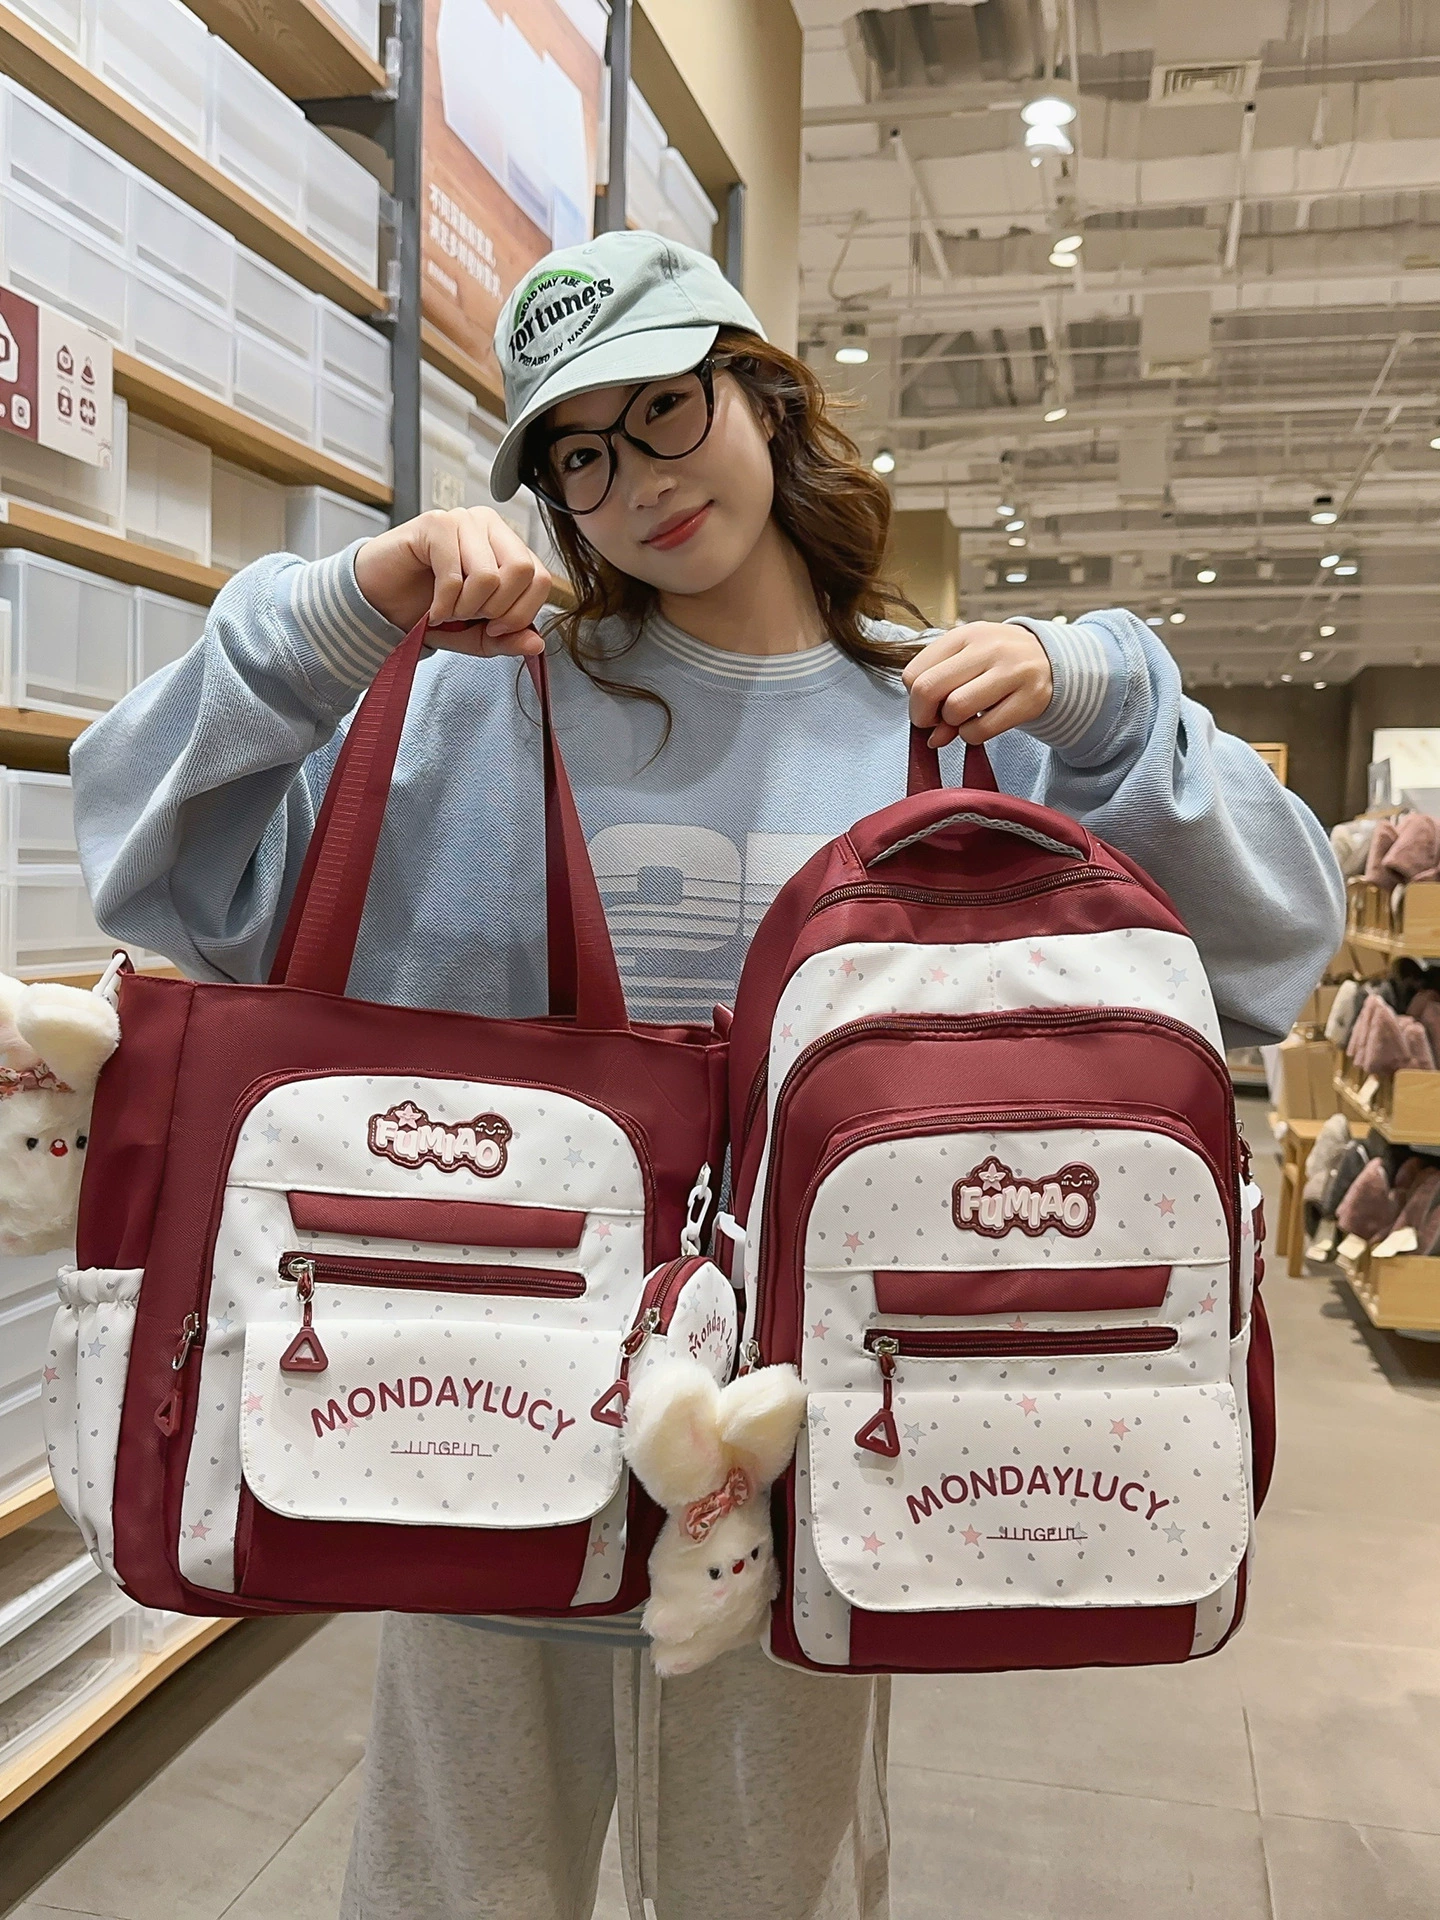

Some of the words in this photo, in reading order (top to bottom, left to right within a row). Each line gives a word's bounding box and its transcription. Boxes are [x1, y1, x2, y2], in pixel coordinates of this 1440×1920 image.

[538, 277, 559, 292] WAY
[553, 342, 563, 357] BY
[311, 1376, 576, 1440] MONDAYLUCY
[906, 1465, 1170, 1525] MONDAYLUCY
